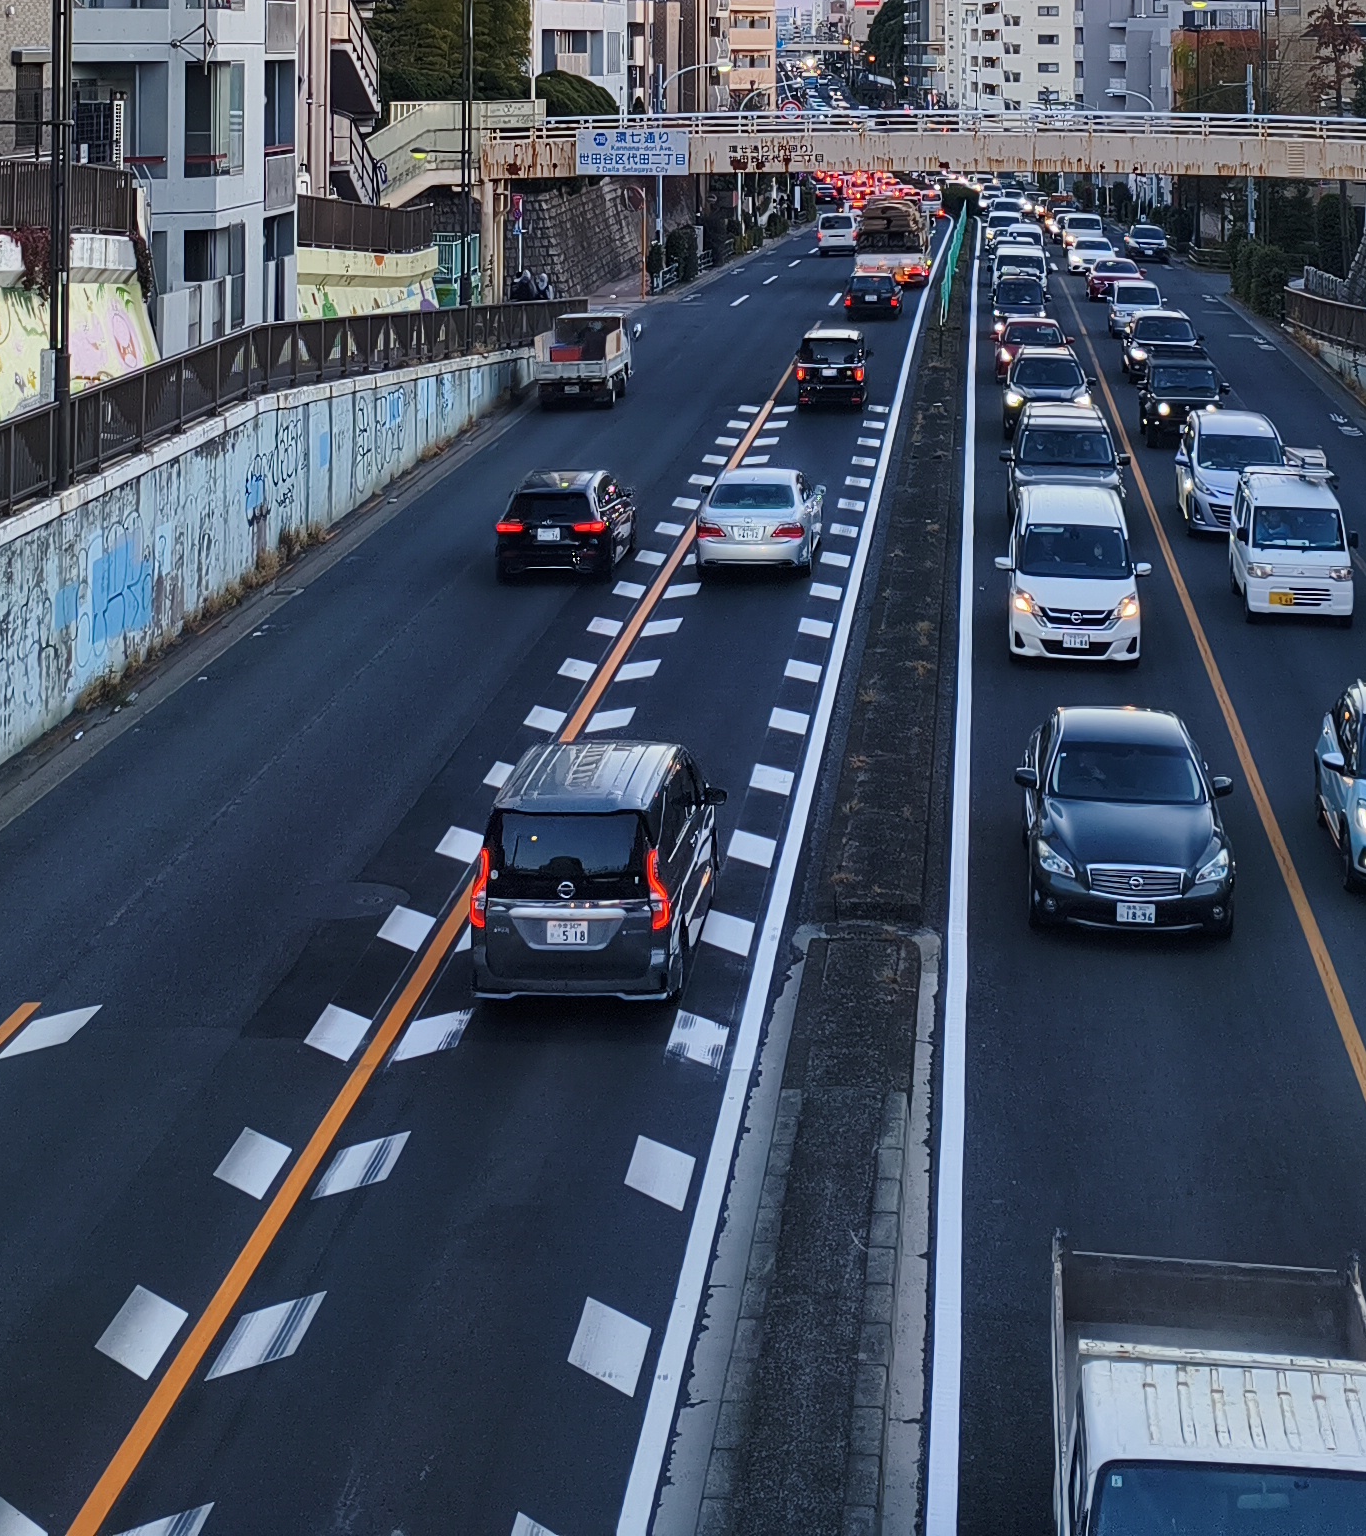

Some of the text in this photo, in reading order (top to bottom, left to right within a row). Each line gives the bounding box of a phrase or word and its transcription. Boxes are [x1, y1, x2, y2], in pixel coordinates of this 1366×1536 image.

[615, 131, 669, 144] 環七通り
[579, 152, 686, 165] 世田谷区代田二丁目
[622, 166, 653, 174] Setagaya
[655, 166, 669, 174] City
